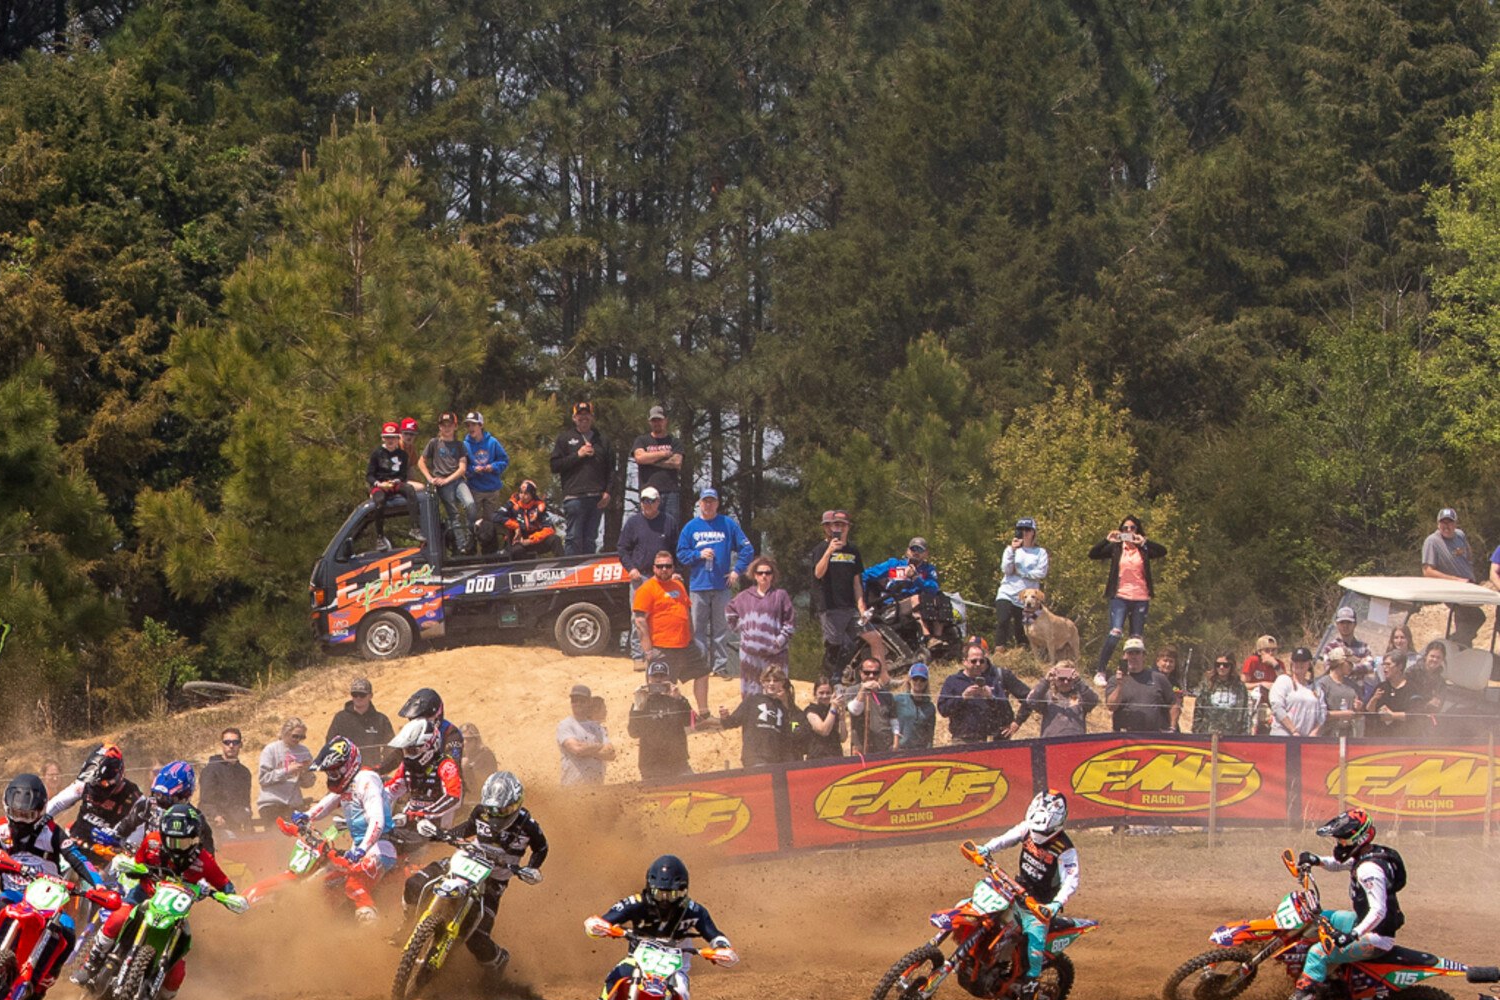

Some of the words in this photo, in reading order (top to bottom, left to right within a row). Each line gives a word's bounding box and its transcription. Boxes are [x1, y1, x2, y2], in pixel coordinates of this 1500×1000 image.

[593, 564, 623, 582] 999
[1074, 753, 1255, 794] FMF
[818, 768, 1002, 819] FMF
[1141, 794, 1186, 805] RACING
[1407, 799, 1454, 810] RACING
[890, 811, 934, 825] RACING
[153, 886, 191, 912] 178
[642, 951, 682, 977] 35
[1393, 970, 1419, 986] 115
